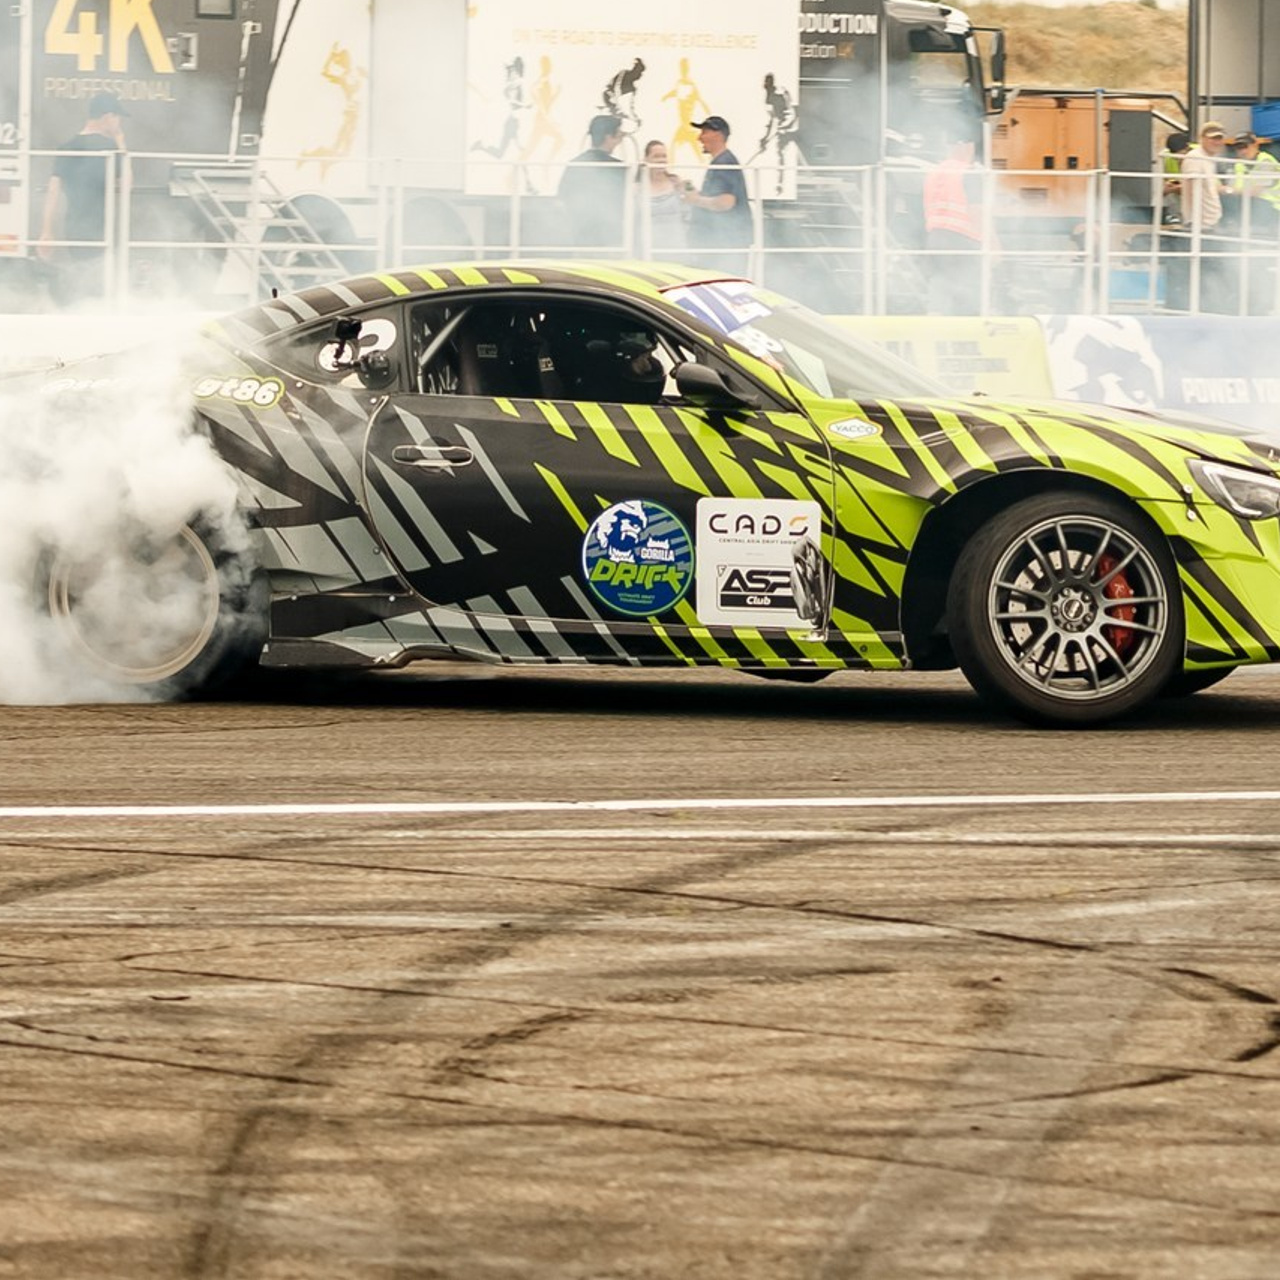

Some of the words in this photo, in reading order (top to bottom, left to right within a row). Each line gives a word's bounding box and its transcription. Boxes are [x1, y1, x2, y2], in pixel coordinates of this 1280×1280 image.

[1181, 377, 1251, 404] POWER
[708, 513, 809, 536] CADS
[746, 595, 772, 605] Club
